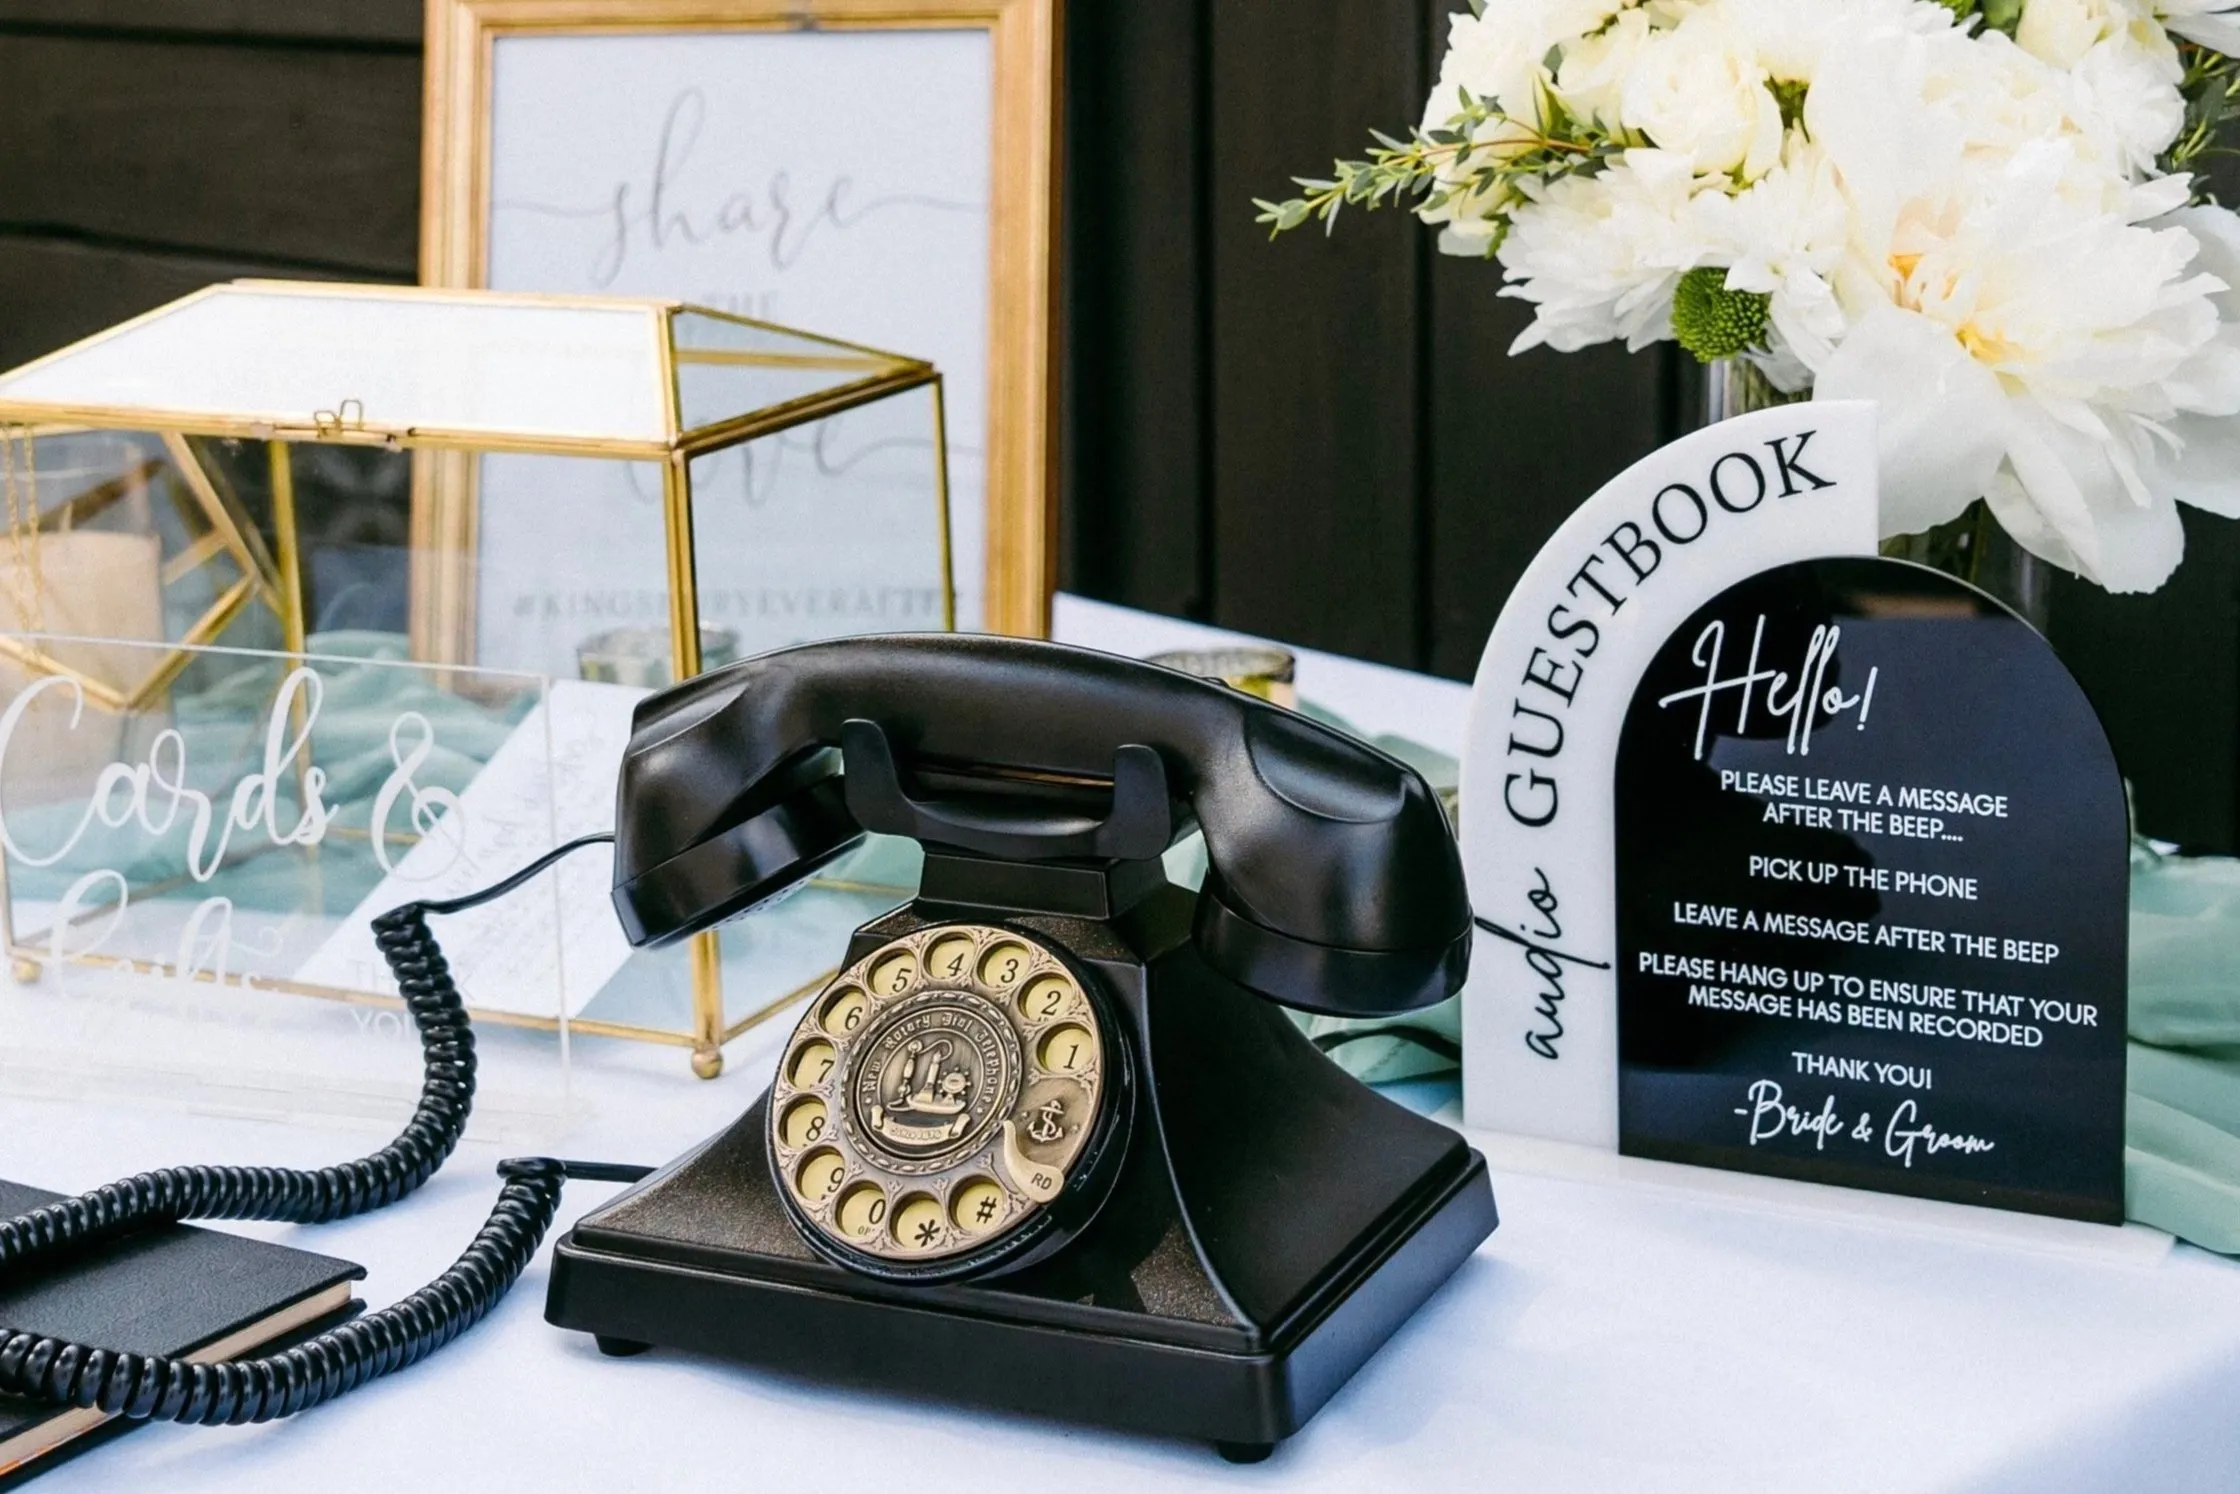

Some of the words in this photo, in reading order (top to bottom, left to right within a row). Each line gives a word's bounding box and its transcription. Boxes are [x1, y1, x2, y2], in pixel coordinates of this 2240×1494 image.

[1504, 429, 1837, 828] GUESTBOOK
[1658, 613, 1878, 760] Hello!
[0, 666, 340, 882] Cards
[371, 710, 480, 882] &
[1720, 769, 1799, 798] PLEASE
[1804, 776, 1872, 805] LEAVE
[1875, 784, 1894, 807] A
[1897, 786, 2009, 818] MESSAGE
[1761, 801, 1833, 829] AFTER
[1836, 808, 1884, 835] THE
[1749, 854, 1804, 882] PICK
[1807, 860, 1839, 885] UP
[1842, 864, 1890, 891] THE
[1895, 870, 1978, 901] PHONE
[1673, 900, 1739, 930] LEAVE
[1741, 909, 1760, 932] A
[1762, 911, 1870, 945] MESSAGE
[1873, 924, 1946, 953] AFTER
[1949, 932, 1998, 959] THE
[2002, 938, 2060, 965] BEEP
[946, 952, 966, 977] 4
[999, 958, 1019, 984] 3
[1474, 867, 1611, 1059] audio
[891, 968, 912, 992] 5
[1638, 951, 1716, 981] PLEASE
[1720, 960, 1789, 989] HANG
[1792, 969, 1825, 993] UP
[1827, 973, 1865, 998] TO
[1869, 978, 1957, 1010] ENSURE
[1960, 989, 2026, 1017] THAT
[2028, 997, 2098, 1028] YOUR
[844, 1006, 863, 1031] 6
[1040, 989, 1062, 1016] 2
[1687, 984, 1793, 1018] MESSAGE
[1797, 997, 1843, 1024] HAS
[1847, 1003, 1904, 1032] BEEN
[1909, 1011, 2044, 1048] RECORDED
[818, 1059, 835, 1083] 7
[1062, 1043, 1080, 1070] 1
[1791, 1051, 1871, 1083] THANK
[1873, 1061, 1932, 1090] YOU!
[805, 1115, 826, 1142] 8
[1850, 1111, 1874, 1143] &
[1884, 1098, 1996, 1169] Groom
[826, 1166, 846, 1194] 9
[1031, 1172, 1053, 1190] RD
[868, 1198, 886, 1225] 0
[975, 1195, 998, 1225] #
